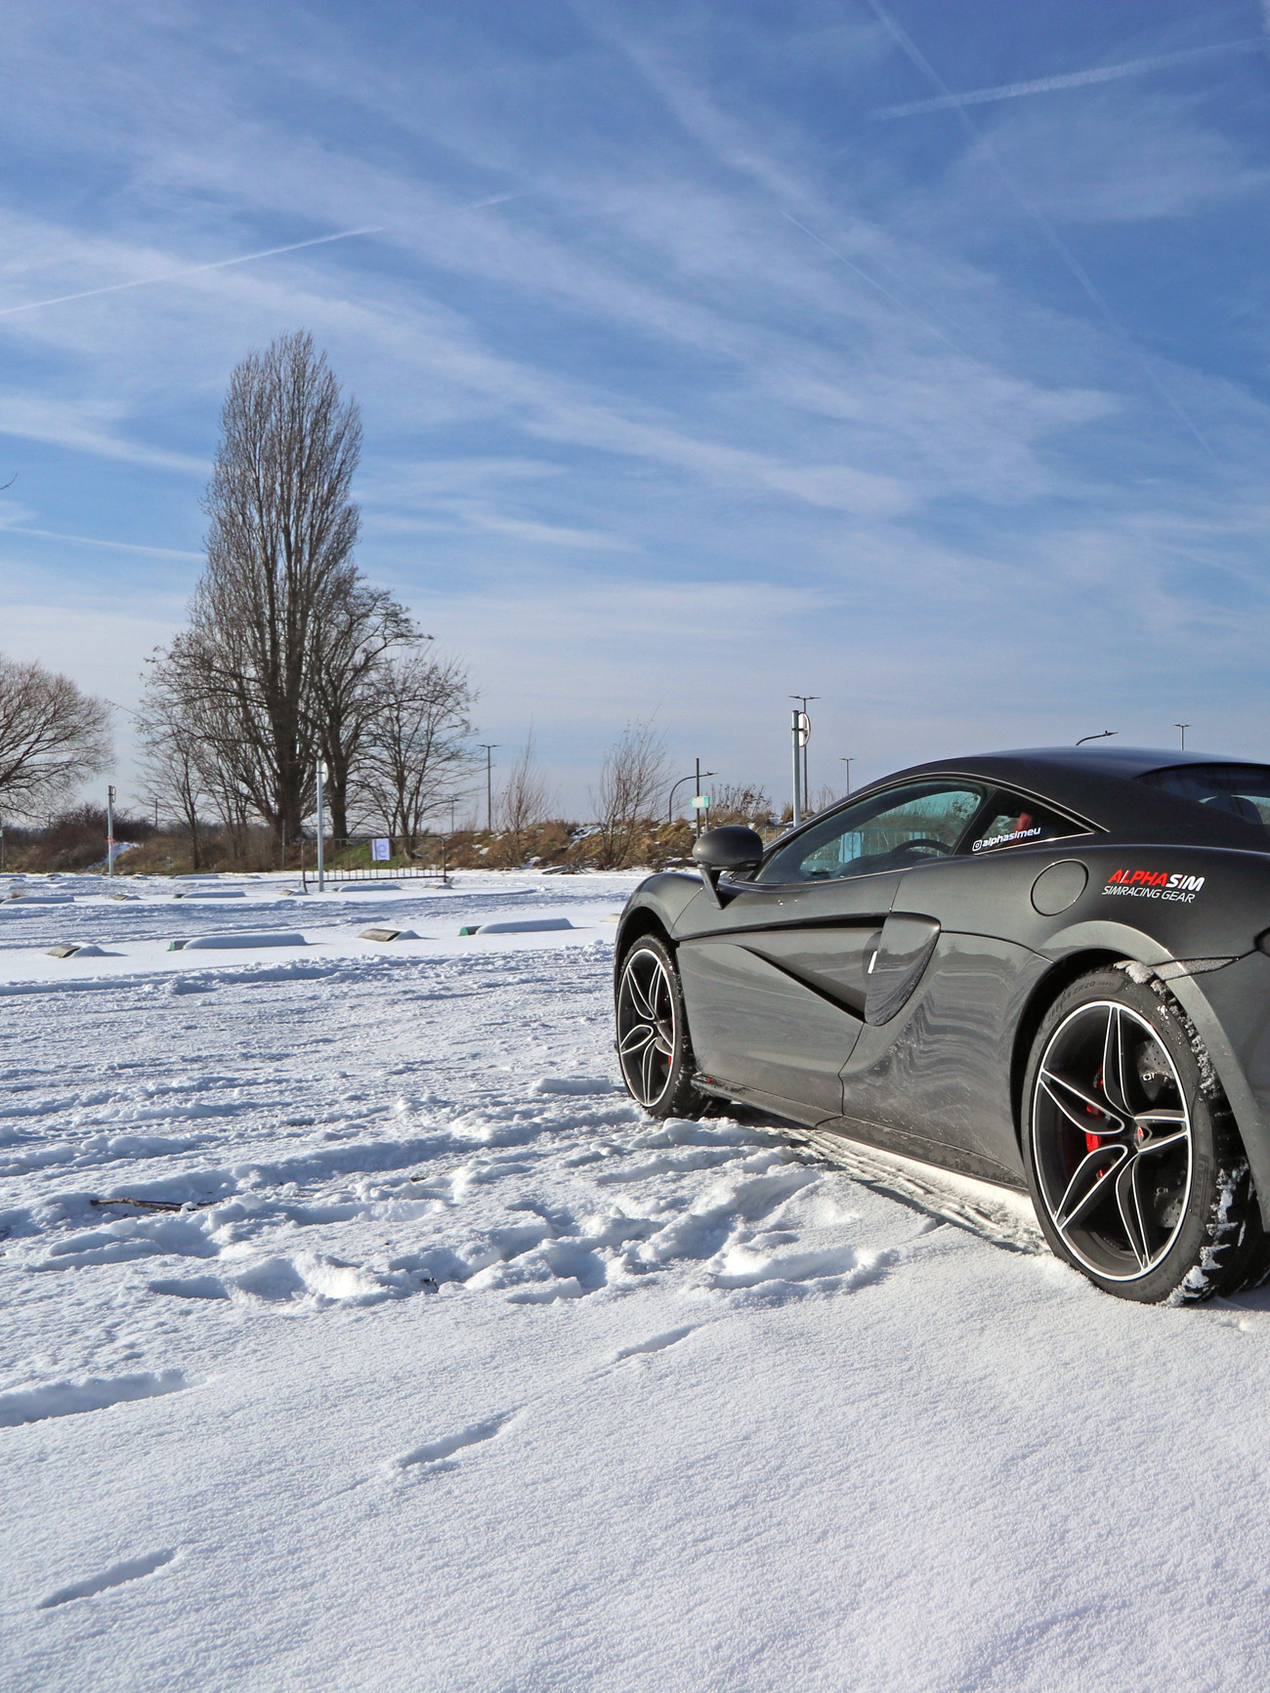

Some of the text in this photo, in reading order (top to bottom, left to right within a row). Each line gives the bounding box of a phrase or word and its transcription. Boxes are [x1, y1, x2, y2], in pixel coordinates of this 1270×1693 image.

[981, 826, 1041, 848] alphasimeu
[1107, 869, 1206, 892] ALPHASIM
[1101, 885, 1197, 904] SIMRACING GEAR
